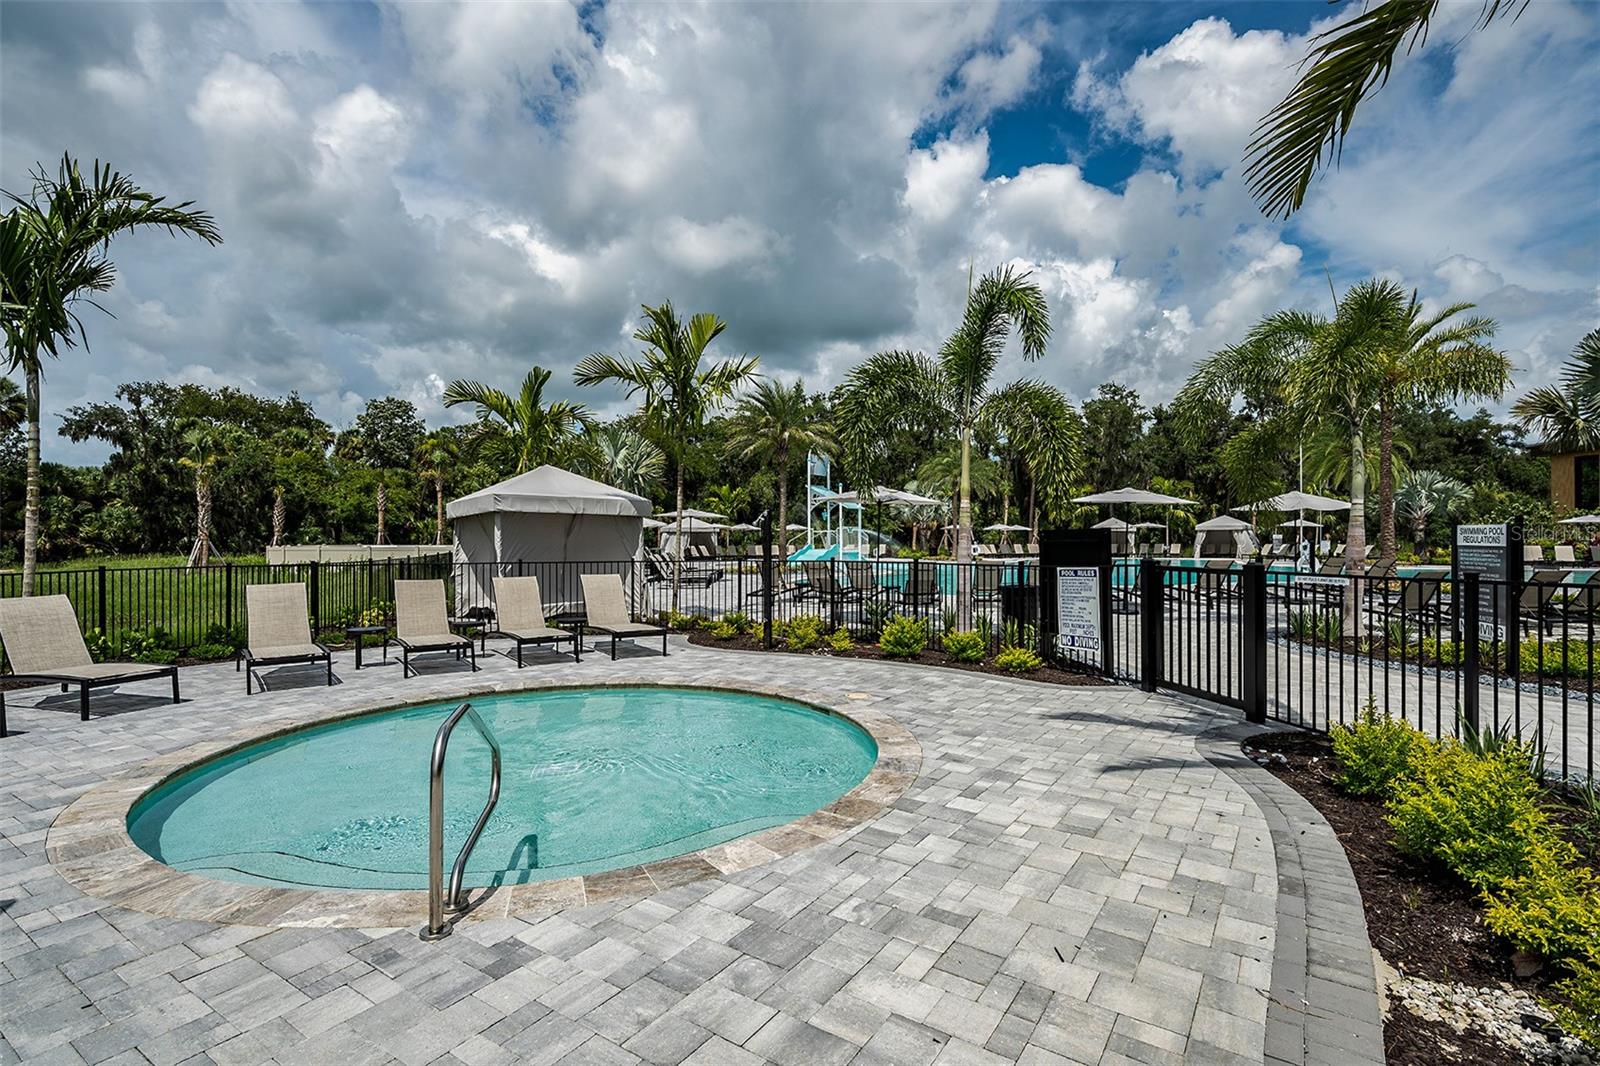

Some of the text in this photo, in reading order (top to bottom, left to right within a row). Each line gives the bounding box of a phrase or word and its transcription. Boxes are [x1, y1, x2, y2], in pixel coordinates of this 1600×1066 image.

[1459, 527, 1504, 535] SWIMMING POOL
[1463, 536, 1501, 544] REGULATIONS
[1061, 635, 1099, 649] NO DIVING
